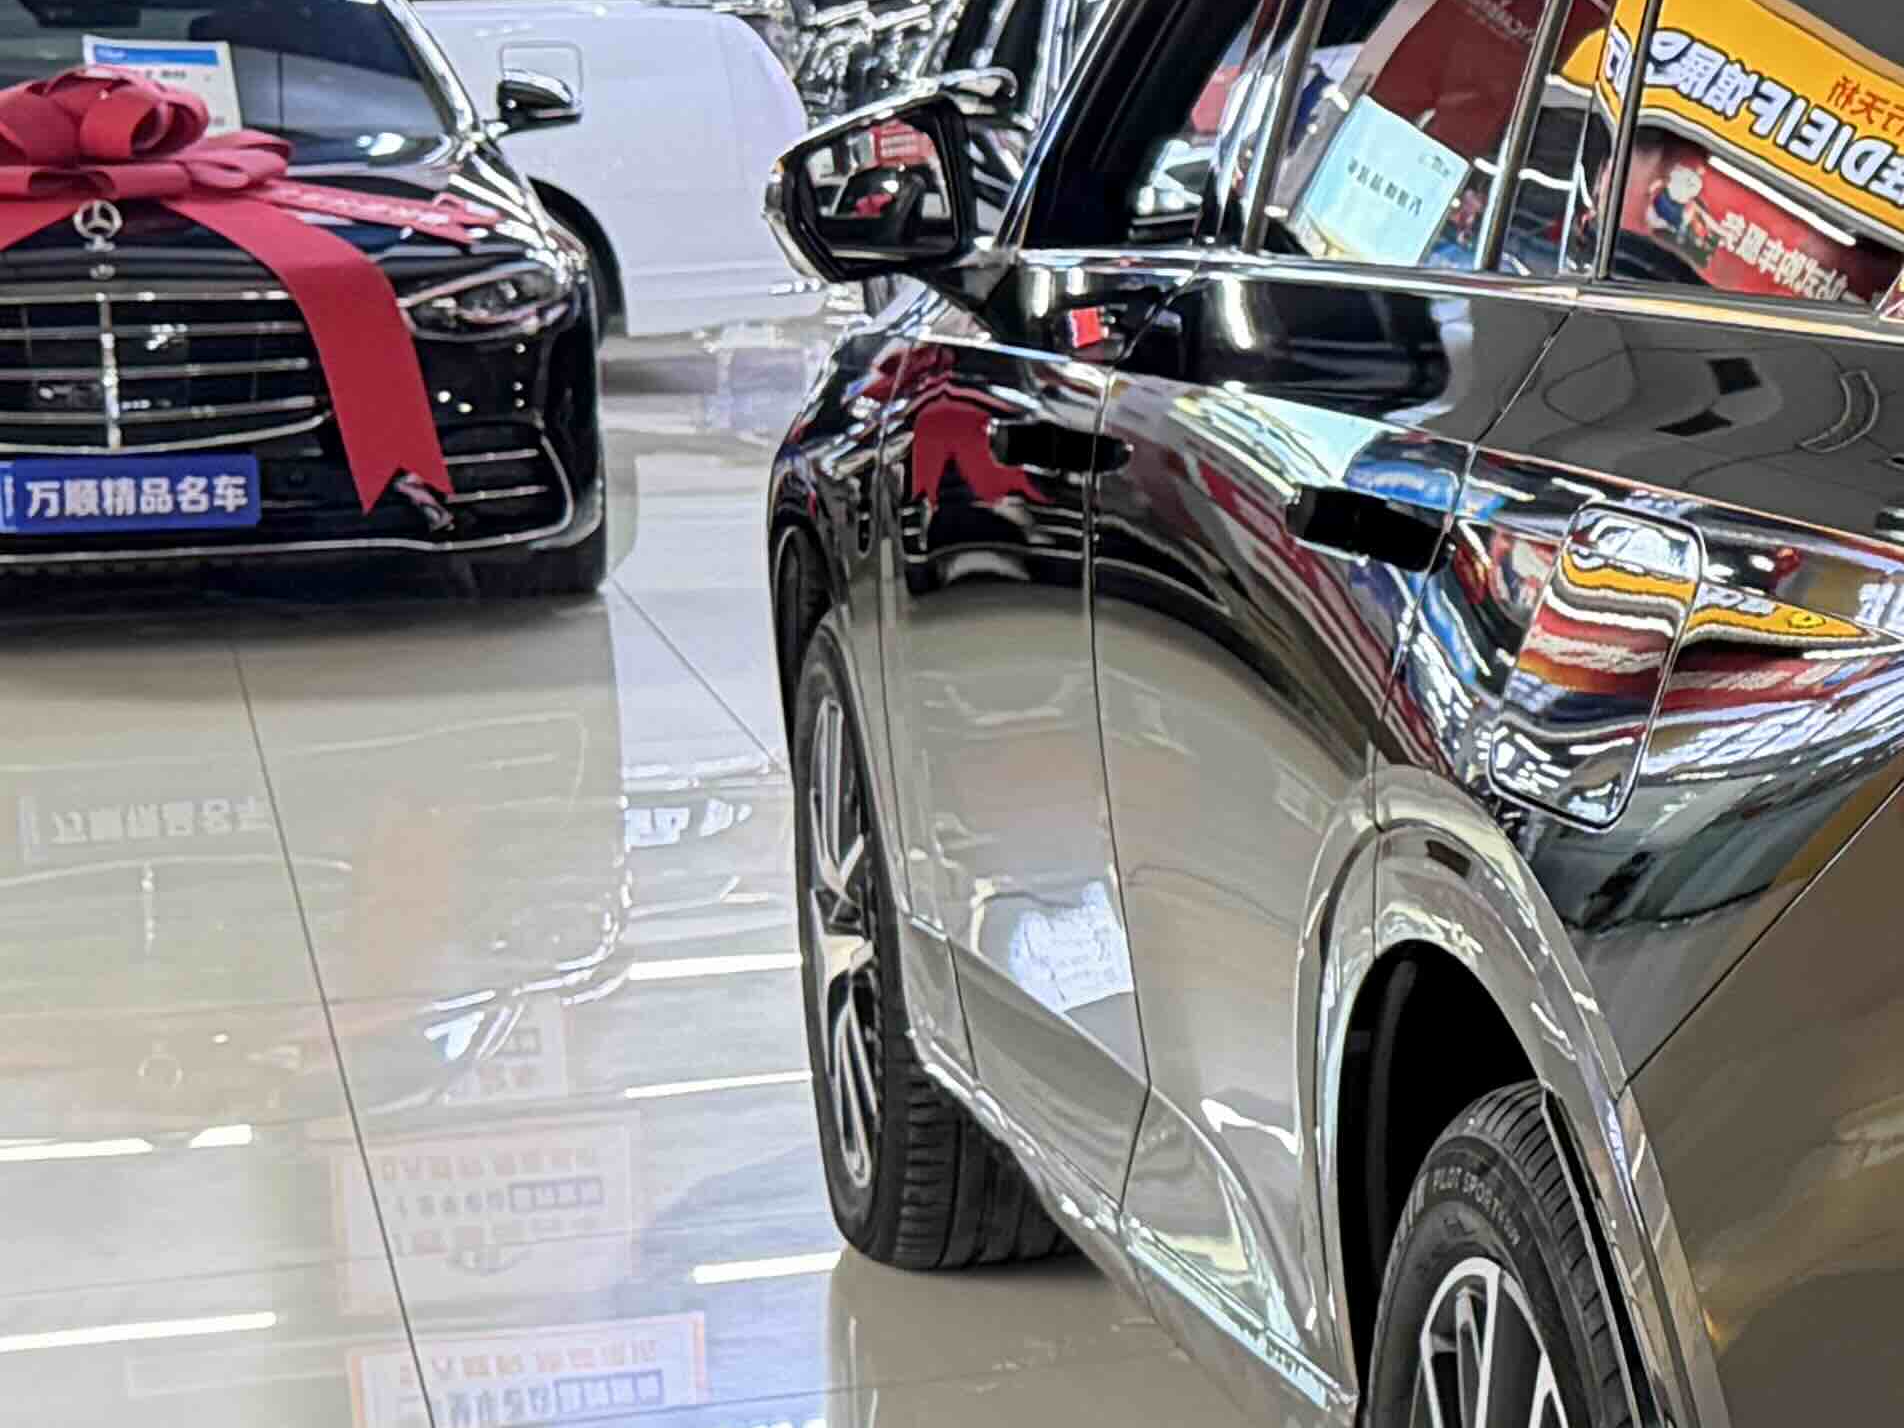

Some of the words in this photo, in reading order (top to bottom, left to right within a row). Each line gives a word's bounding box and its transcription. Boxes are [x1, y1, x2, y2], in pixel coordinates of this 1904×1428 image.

[25, 474, 249, 518] 万顺精品名车
